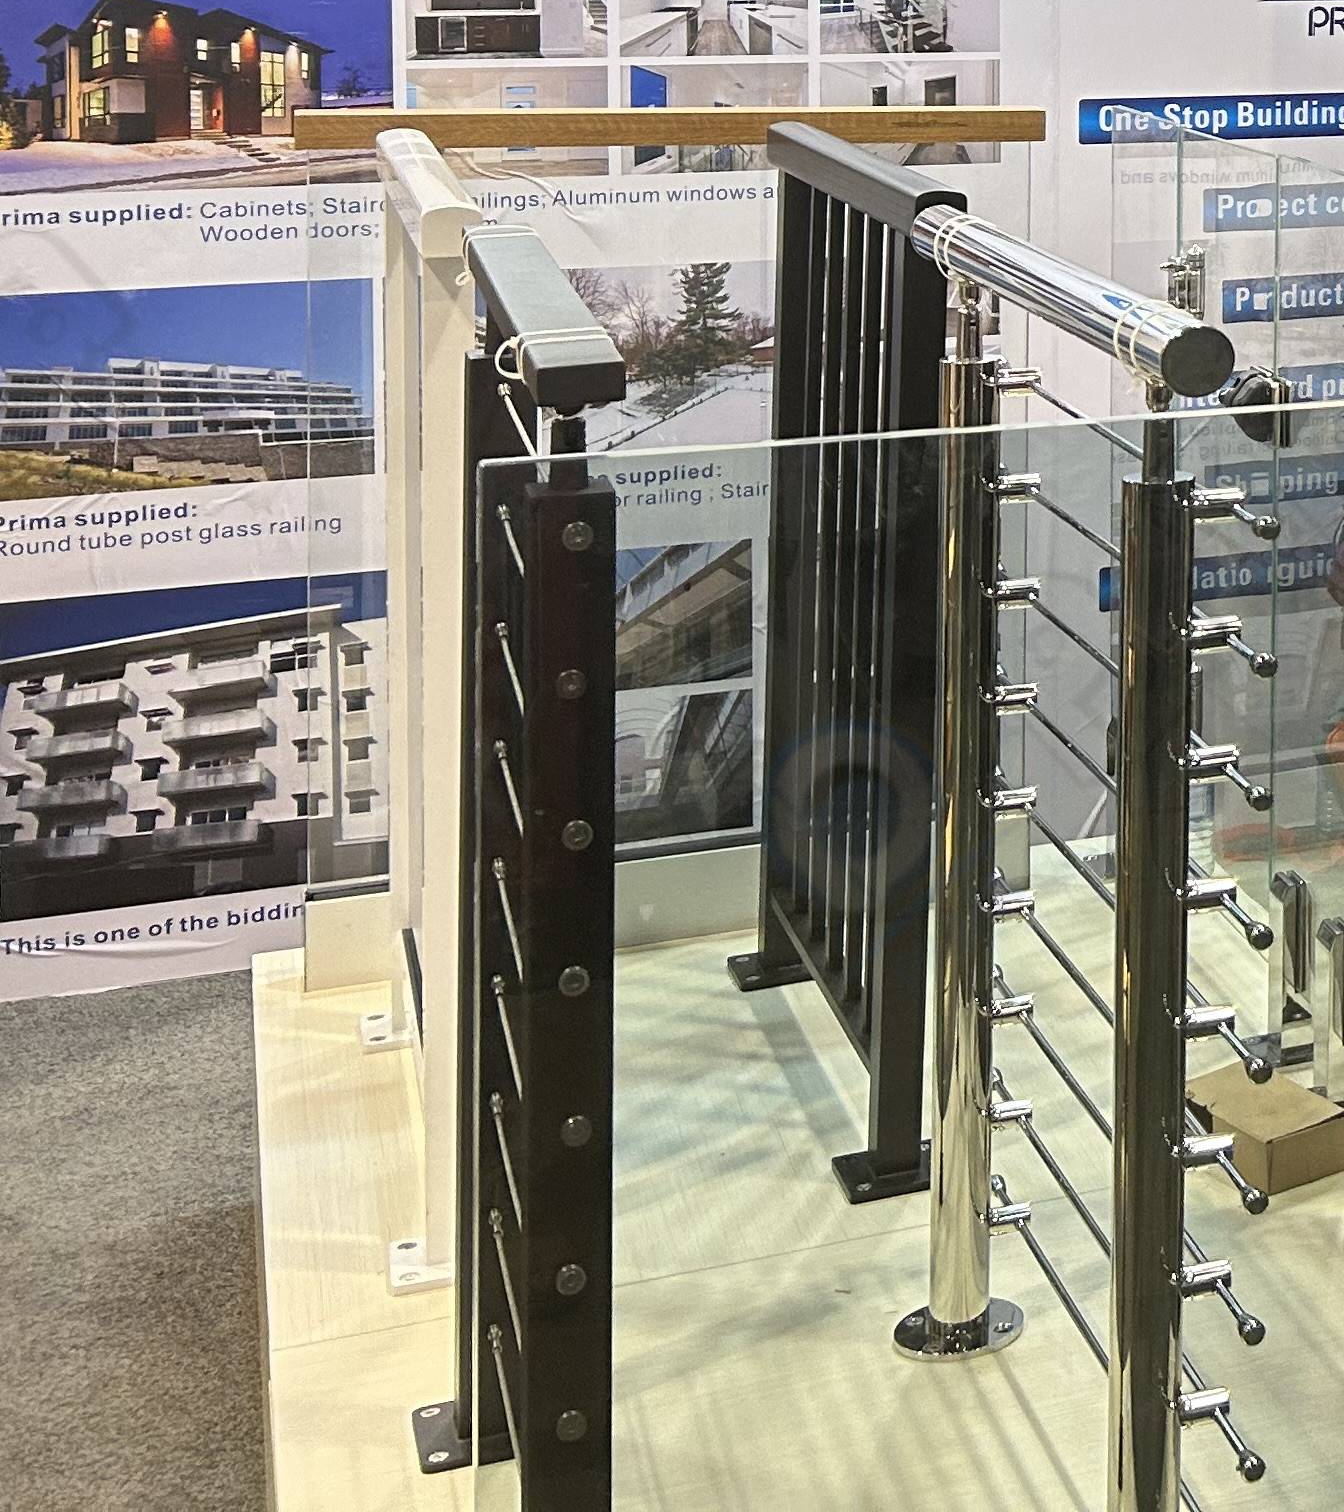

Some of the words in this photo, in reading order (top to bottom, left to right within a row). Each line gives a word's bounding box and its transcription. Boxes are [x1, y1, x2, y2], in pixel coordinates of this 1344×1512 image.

[1099, 104, 1149, 132] One
[1158, 104, 1228, 135] Stop
[552, 188, 660, 207] Aluminum
[666, 185, 758, 203] windows
[1216, 195, 1318, 219] Proect
[1, 207, 61, 227] rima
[68, 202, 192, 227] supplied:
[200, 200, 313, 219] Cabinets;
[200, 224, 298, 242] Wooden
[306, 222, 380, 239] doors;
[616, 463, 722, 486] supplied:
[637, 488, 702, 506] railing
[721, 482, 769, 499] Stair
[74, 502, 199, 528] supplied:
[79, 531, 132, 551] tube
[140, 527, 192, 549] post
[199, 522, 262, 545] glass
[269, 516, 342, 535] railing
[3, 938, 56, 955] This
[64, 931, 86, 948] is
[94, 926, 141, 944] one
[149, 918, 174, 937] of
[180, 913, 220, 932] the
[227, 902, 306, 927] biddin
